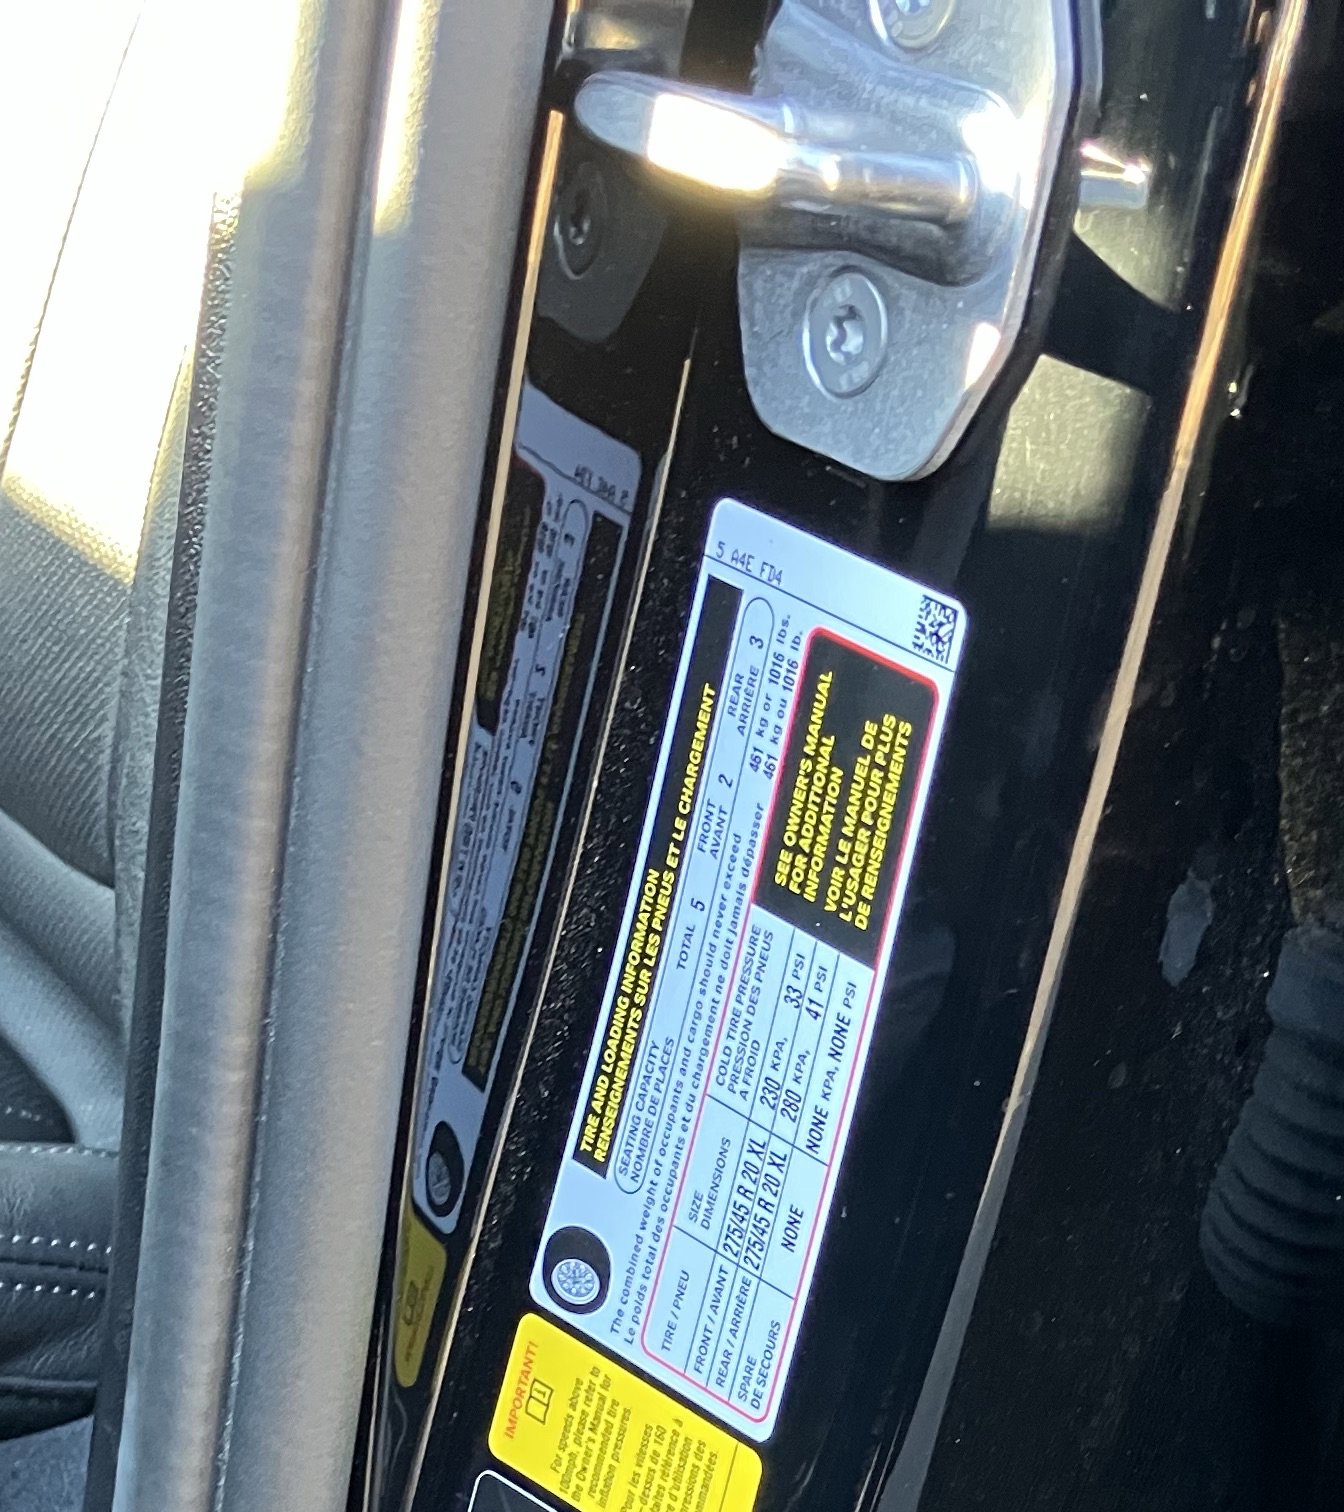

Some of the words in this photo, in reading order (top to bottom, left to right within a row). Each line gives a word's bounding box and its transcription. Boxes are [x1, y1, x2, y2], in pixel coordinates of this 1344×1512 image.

[747, 632, 765, 651] 3
[725, 670, 746, 718] REAR
[732, 662, 761, 738] ARRIÈRE
[761, 690, 775, 714] or
[775, 696, 789, 721] ou
[801, 666, 835, 757] MANUAL
[674, 681, 719, 817] CHARGEMENT
[754, 715, 770, 740] kg
[768, 722, 784, 747] kg
[859, 718, 880, 751] DE
[872, 711, 898, 767] PLUS
[716, 771, 734, 789] 2
[746, 743, 765, 775] 461
[780, 755, 815, 849] OWNER'S
[795, 730, 838, 854] ADDITIONAL
[839, 749, 873, 838] MANUEL
[857, 718, 915, 901] RENSEIGNEMENTS
[859, 766, 886, 827] POUR
[670, 814, 688, 843] LE
[695, 796, 718, 854] FRONT
[707, 803, 729, 860] AVANT
[737, 800, 768, 881] dépasser
[800, 764, 846, 904] INFORMATION
[664, 840, 682, 870] ET
[719, 831, 744, 892] exceed
[772, 846, 794, 888] SEE
[833, 836, 853, 866] LE
[787, 852, 809, 895] FOR
[822, 863, 847, 915] VOIR
[836, 825, 873, 924] L'USAGER
[649, 867, 676, 933] PNEUS
[710, 891, 730, 941] never
[725, 878, 749, 937] jamais
[852, 898, 872, 932] DE
[619, 865, 661, 996] INFORMATION
[641, 929, 662, 968] LES
[674, 920, 697, 974] TOTAL
[688, 895, 707, 914] 5
[695, 939, 718, 998] should
[717, 935, 735, 972] doit
[733, 922, 763, 1006] PRESSURE
[752, 927, 775, 984] PNEUS
[790, 950, 806, 981] PSI
[632, 965, 653, 1008] SUR
[712, 971, 726, 996] ne
[744, 982, 762, 1017] DES
[782, 982, 804, 1010] 33
[812, 963, 829, 994] PSI
[685, 998, 705, 1046] cargo
[724, 1005, 743, 1044] TIRE
[803, 995, 825, 1023] 41
[599, 991, 631, 1075] LOADING
[688, 993, 722, 1092] chargement
[768, 1032, 789, 1073] KPA,
[652, 1034, 675, 1095] PLACES
[676, 1044, 693, 1078] and
[714, 1042, 734, 1088] COLD
[726, 1016, 753, 1096] PRESSION
[741, 1036, 762, 1087] FROID
[791, 1045, 811, 1086] KPA,
[804, 1102, 830, 1155] NONE
[826, 1010, 852, 1063] NONE
[841, 979, 858, 1010] PSI
[589, 1071, 610, 1115] AND
[593, 1003, 644, 1165] RENSEIGNEMENTS
[645, 1092, 661, 1118] DE
[682, 1090, 697, 1115] du
[738, 1086, 750, 1102] A
[758, 1073, 782, 1112] 230
[778, 1086, 803, 1124] 280
[617, 1111, 642, 1178] SEATING
[633, 1037, 661, 1114] CAPACITY
[656, 1077, 686, 1160] occupants
[677, 1112, 691, 1134] et
[579, 1112, 600, 1155] TIRE
[629, 1115, 655, 1185] NOMBRE
[745, 1133, 767, 1162] XL
[650, 1156, 665, 1178] of
[657, 1132, 687, 1215] occupants
[739, 1158, 761, 1187] 20
[765, 1145, 788, 1174] XL
[699, 1133, 732, 1232] DIMENSIONS
[735, 1182, 755, 1203] R
[759, 1170, 782, 1199] 20
[636, 1176, 660, 1234] weight
[686, 1188, 704, 1225] SIZE
[755, 1194, 776, 1215] R
[649, 1213, 666, 1245] des
[720, 1198, 751, 1260] 275/45
[741, 1210, 772, 1272] 275/45
[779, 1202, 805, 1254] NONE
[617, 1231, 645, 1308] combined
[639, 1242, 658, 1282] total
[609, 1305, 626, 1338] The
[628, 1280, 649, 1326] poids
[659, 1318, 678, 1355] TIRE
[671, 1267, 691, 1311] PNEU
[692, 1322, 714, 1376] FRONT
[707, 1262, 730, 1317] AVANT
[622, 1324, 637, 1346] Le
[714, 1346, 734, 1389] REAR
[725, 1272, 752, 1339] ARRIÈRE
[588, 1363, 601, 1380] to
[755, 1316, 782, 1390] SECOURS
[501, 1338, 540, 1441] IMPORTANT!
[565, 1374, 585, 1412] above
[580, 1377, 598, 1409] refer
[598, 1371, 613, 1393] for
[736, 1353, 758, 1404] SPARE
[749, 1385, 764, 1411] DE
[554, 1410, 576, 1454] speeds
[570, 1406, 591, 1449] please
[587, 1390, 608, 1436] Manual
[548, 1449, 565, 1475] For
[574, 1433, 597, 1483] Owner's
[584, 1417, 615, 1499] recommended
[647, 1446, 661, 1466] de
[691, 1437, 708, 1463] des
[569, 1480, 584, 1504] the
[627, 1467, 642, 1490] les
